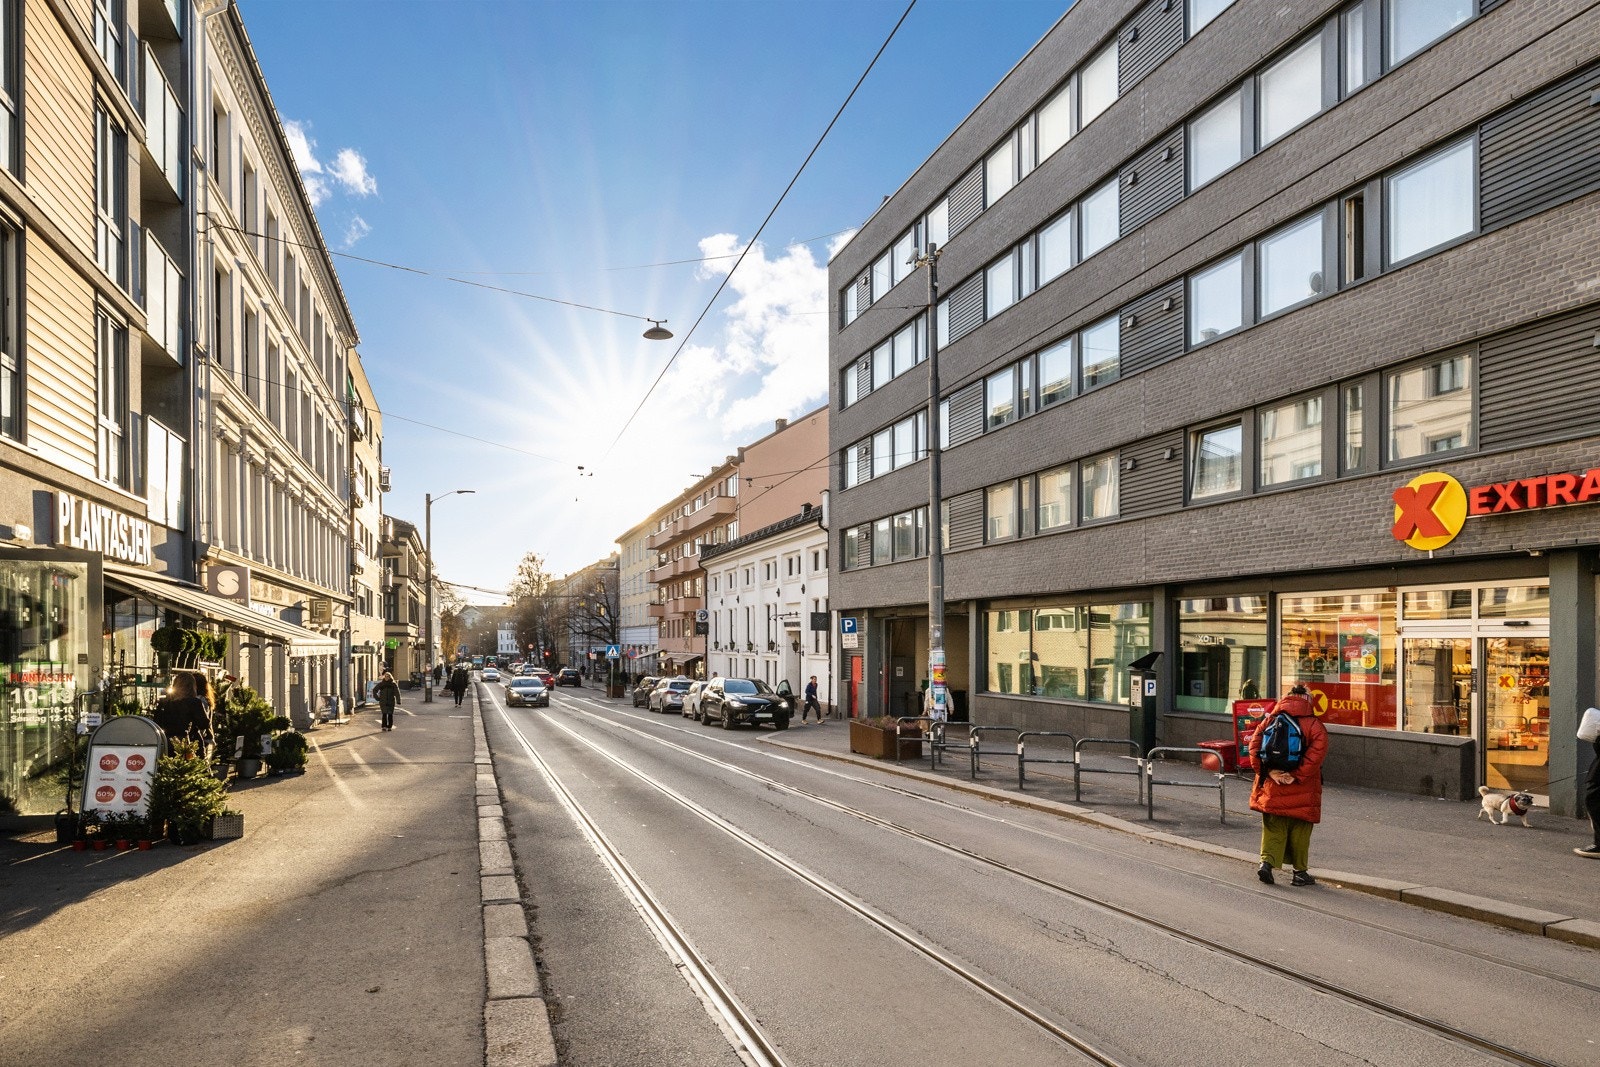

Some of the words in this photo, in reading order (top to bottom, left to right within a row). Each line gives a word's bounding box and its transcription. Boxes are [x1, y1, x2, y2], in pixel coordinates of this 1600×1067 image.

[1469, 468, 1600, 516] EXTRA
[58, 490, 152, 567] PLANTASJEN
[313, 600, 329, 617] F
[844, 619, 854, 632] P
[10, 672, 74, 682] PLANTASJEN
[1147, 682, 1155, 694] P
[1331, 699, 1369, 712] EXTRA
[10, 715, 47, 724] Søndag
